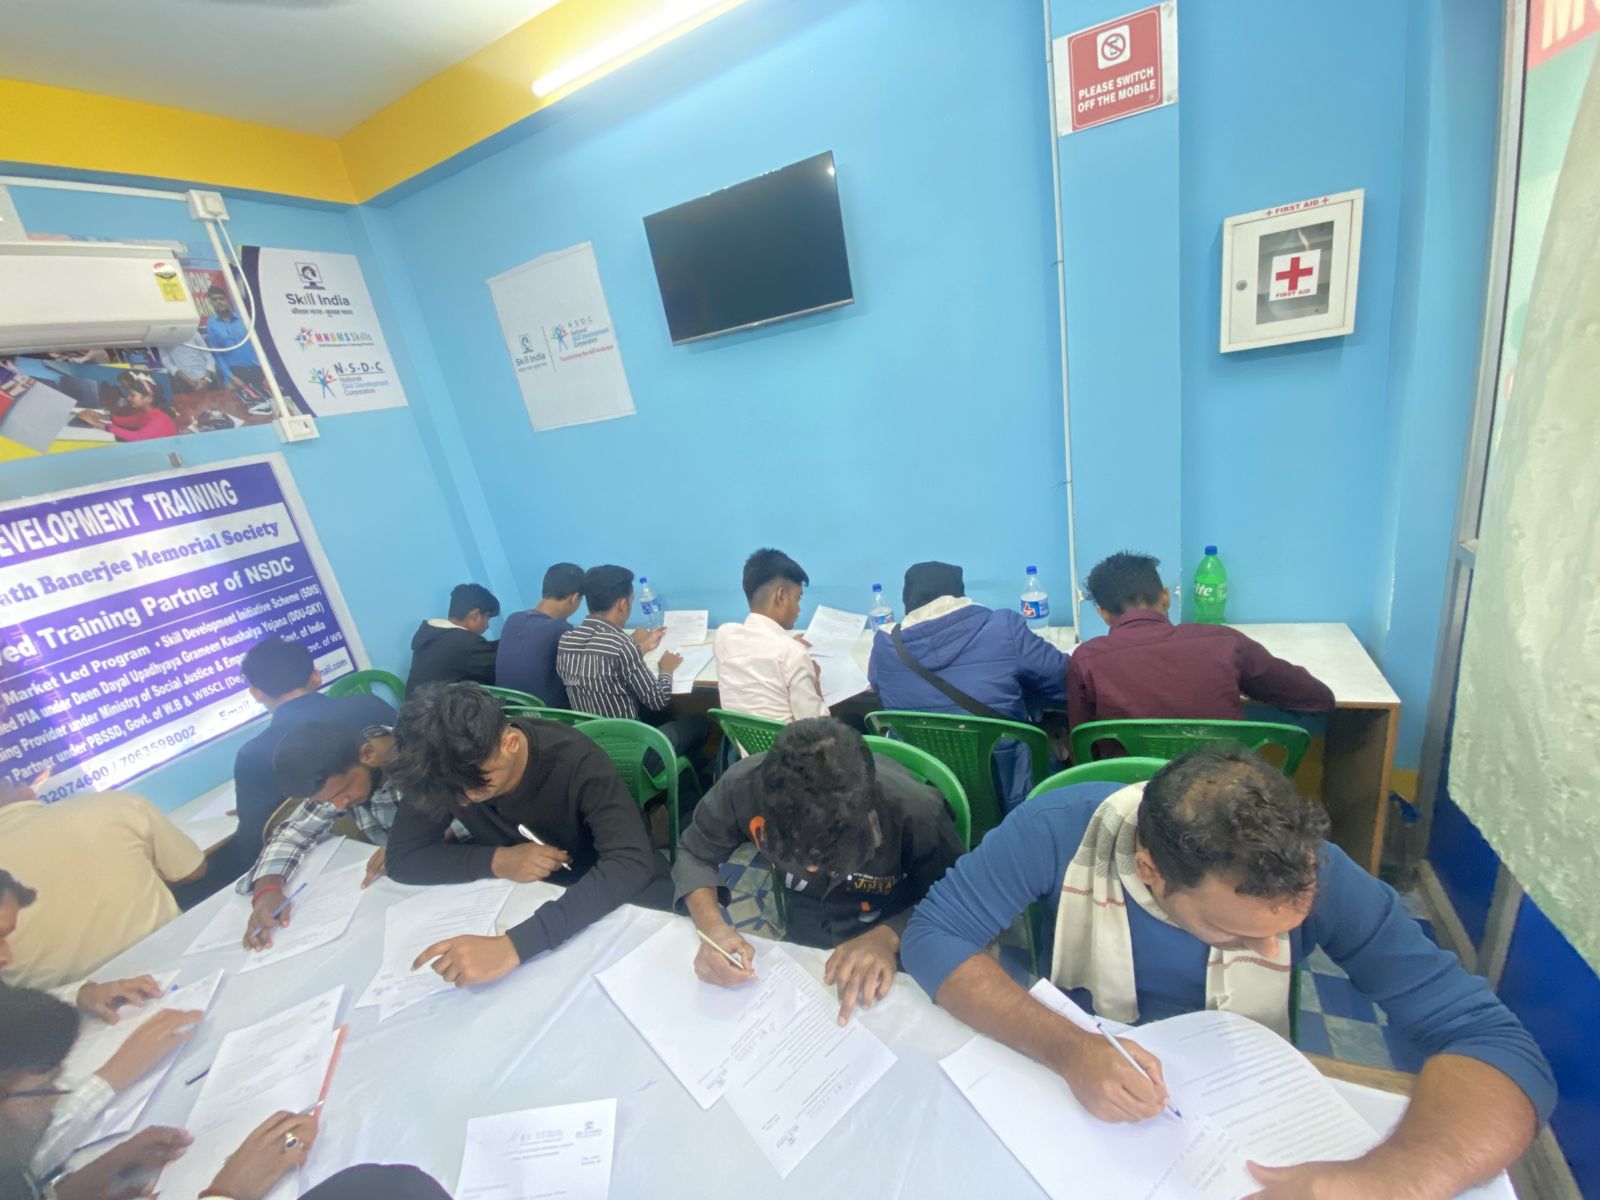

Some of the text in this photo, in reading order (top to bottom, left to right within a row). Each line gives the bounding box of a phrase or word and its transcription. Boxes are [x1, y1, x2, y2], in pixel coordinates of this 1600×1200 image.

[1077, 80, 1156, 113] OFF THE MOBILE
[1078, 66, 1154, 100] PLEASE SWITCH
[1275, 199, 1319, 215] FIRST AID
[286, 293, 351, 306] Skill India
[1275, 290, 1296, 298] FIRST
[530, 352, 546, 362] India
[142, 479, 238, 521] TRAINING
[37, 561, 132, 595] Banerjee
[131, 533, 222, 569] Memorial
[221, 521, 279, 547] Society
[0, 556, 295, 667] ed Training Partner of NSDC
[300, 626, 308, 638] of
[307, 621, 326, 634] India
[1, 584, 322, 705] Market Led Program Skill Development Initiative Scheme (SDIS)
[322, 636, 330, 647] of
[16, 708, 41, 727] PIA
[40, 698, 72, 718] under
[70, 687, 102, 705] Deen
[99, 673, 131, 694] Dayal
[129, 657, 182, 683] Upadhyaya
[181, 642, 222, 662] Grameen
[220, 626, 263, 648] Kaushalya
[261, 617, 289, 632] Yojana
[287, 601, 324, 625] (DDU-GKY)
[20, 725, 68, 751] Provider
[68, 712, 99, 732] under
[98, 695, 141, 719] Ministry
[140, 688, 152, 702] of
[151, 676, 183, 697] Social
[184, 666, 215, 685] Justice
[214, 660, 224, 672] &
[11, 756, 56, 781] Partner
[55, 742, 87, 762] under
[86, 724, 127, 748] PBSSD,
[124, 713, 152, 731] Govt.
[152, 706, 163, 720] of
[162, 699, 183, 715] W.B
[183, 695, 192, 707] &
[192, 681, 226, 701] WBSCL
[39, 766, 110, 804] 32074600
[119, 725, 197, 768] 7063598002
